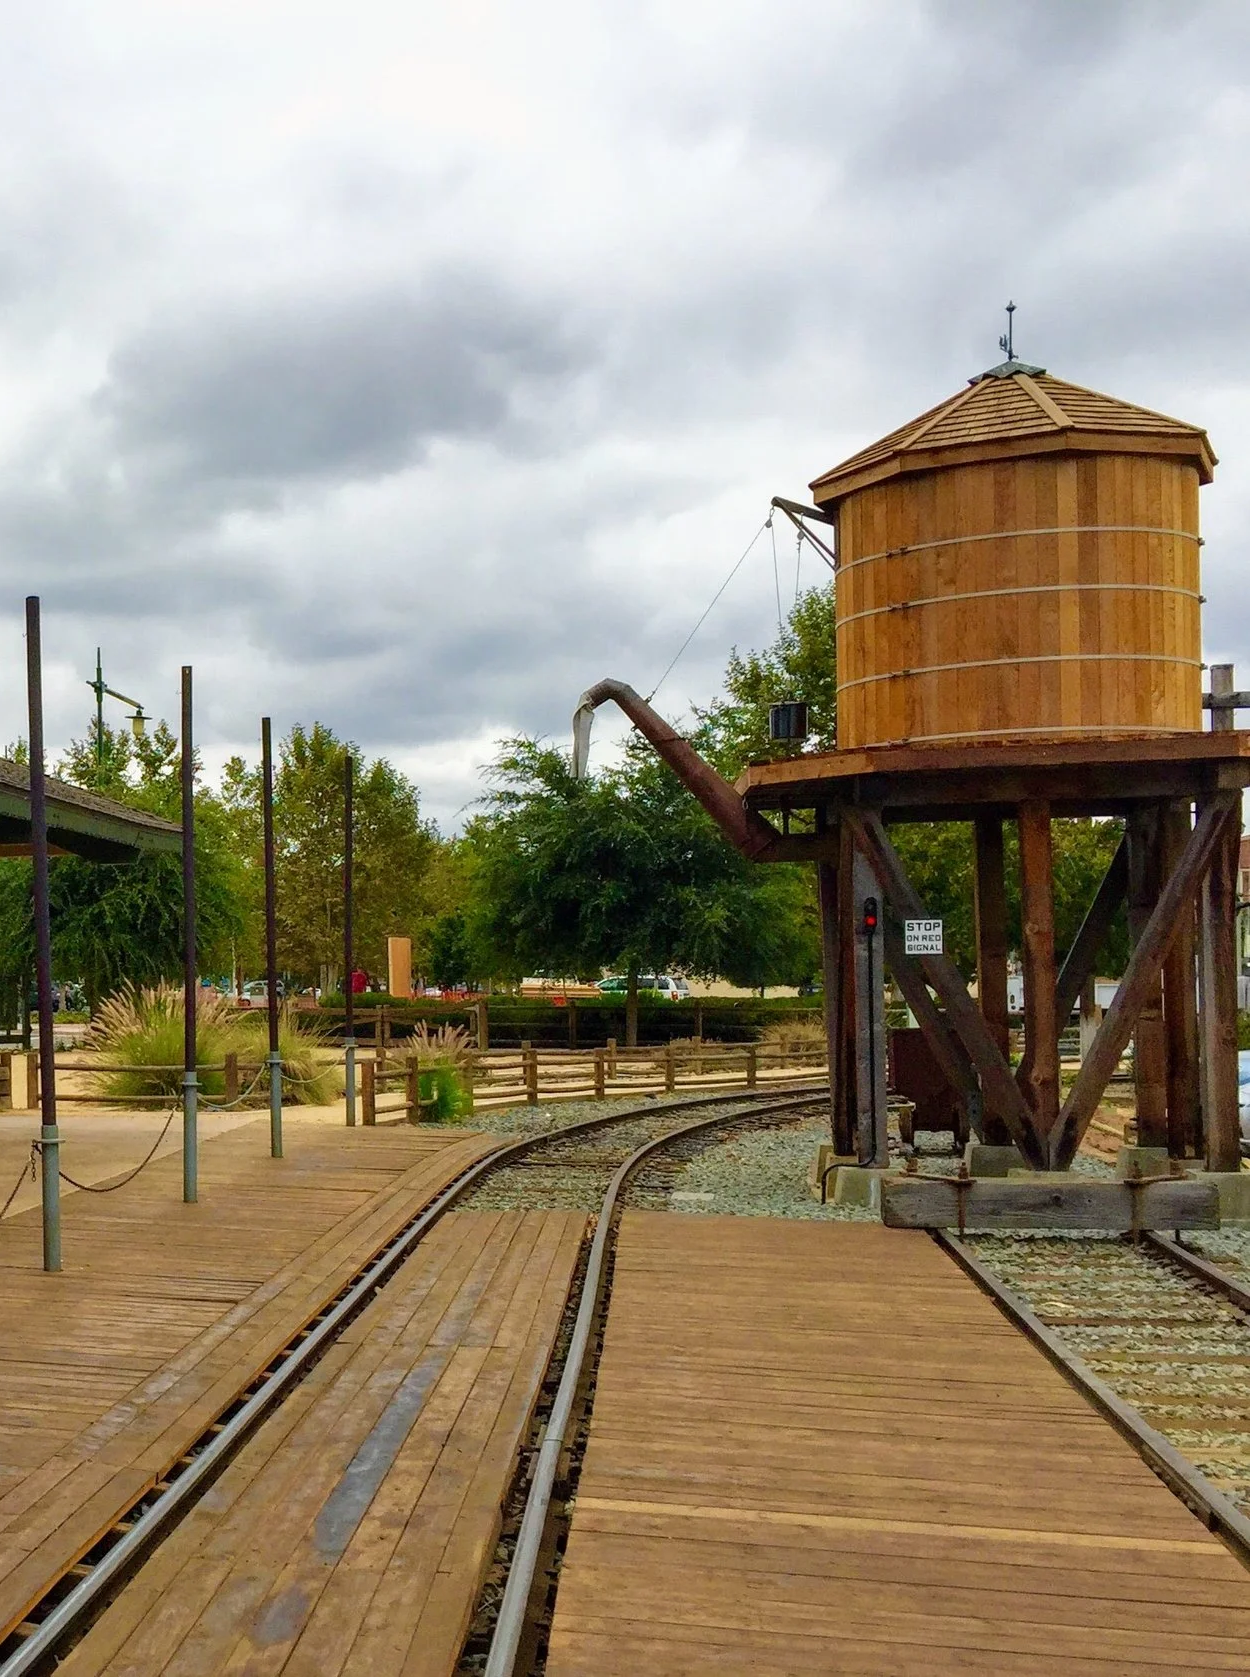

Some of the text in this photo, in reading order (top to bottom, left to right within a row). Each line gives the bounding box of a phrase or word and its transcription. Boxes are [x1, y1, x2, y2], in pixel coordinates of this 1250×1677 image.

[907, 922, 940, 931] STOP
[906, 934, 941, 942] ON RED
